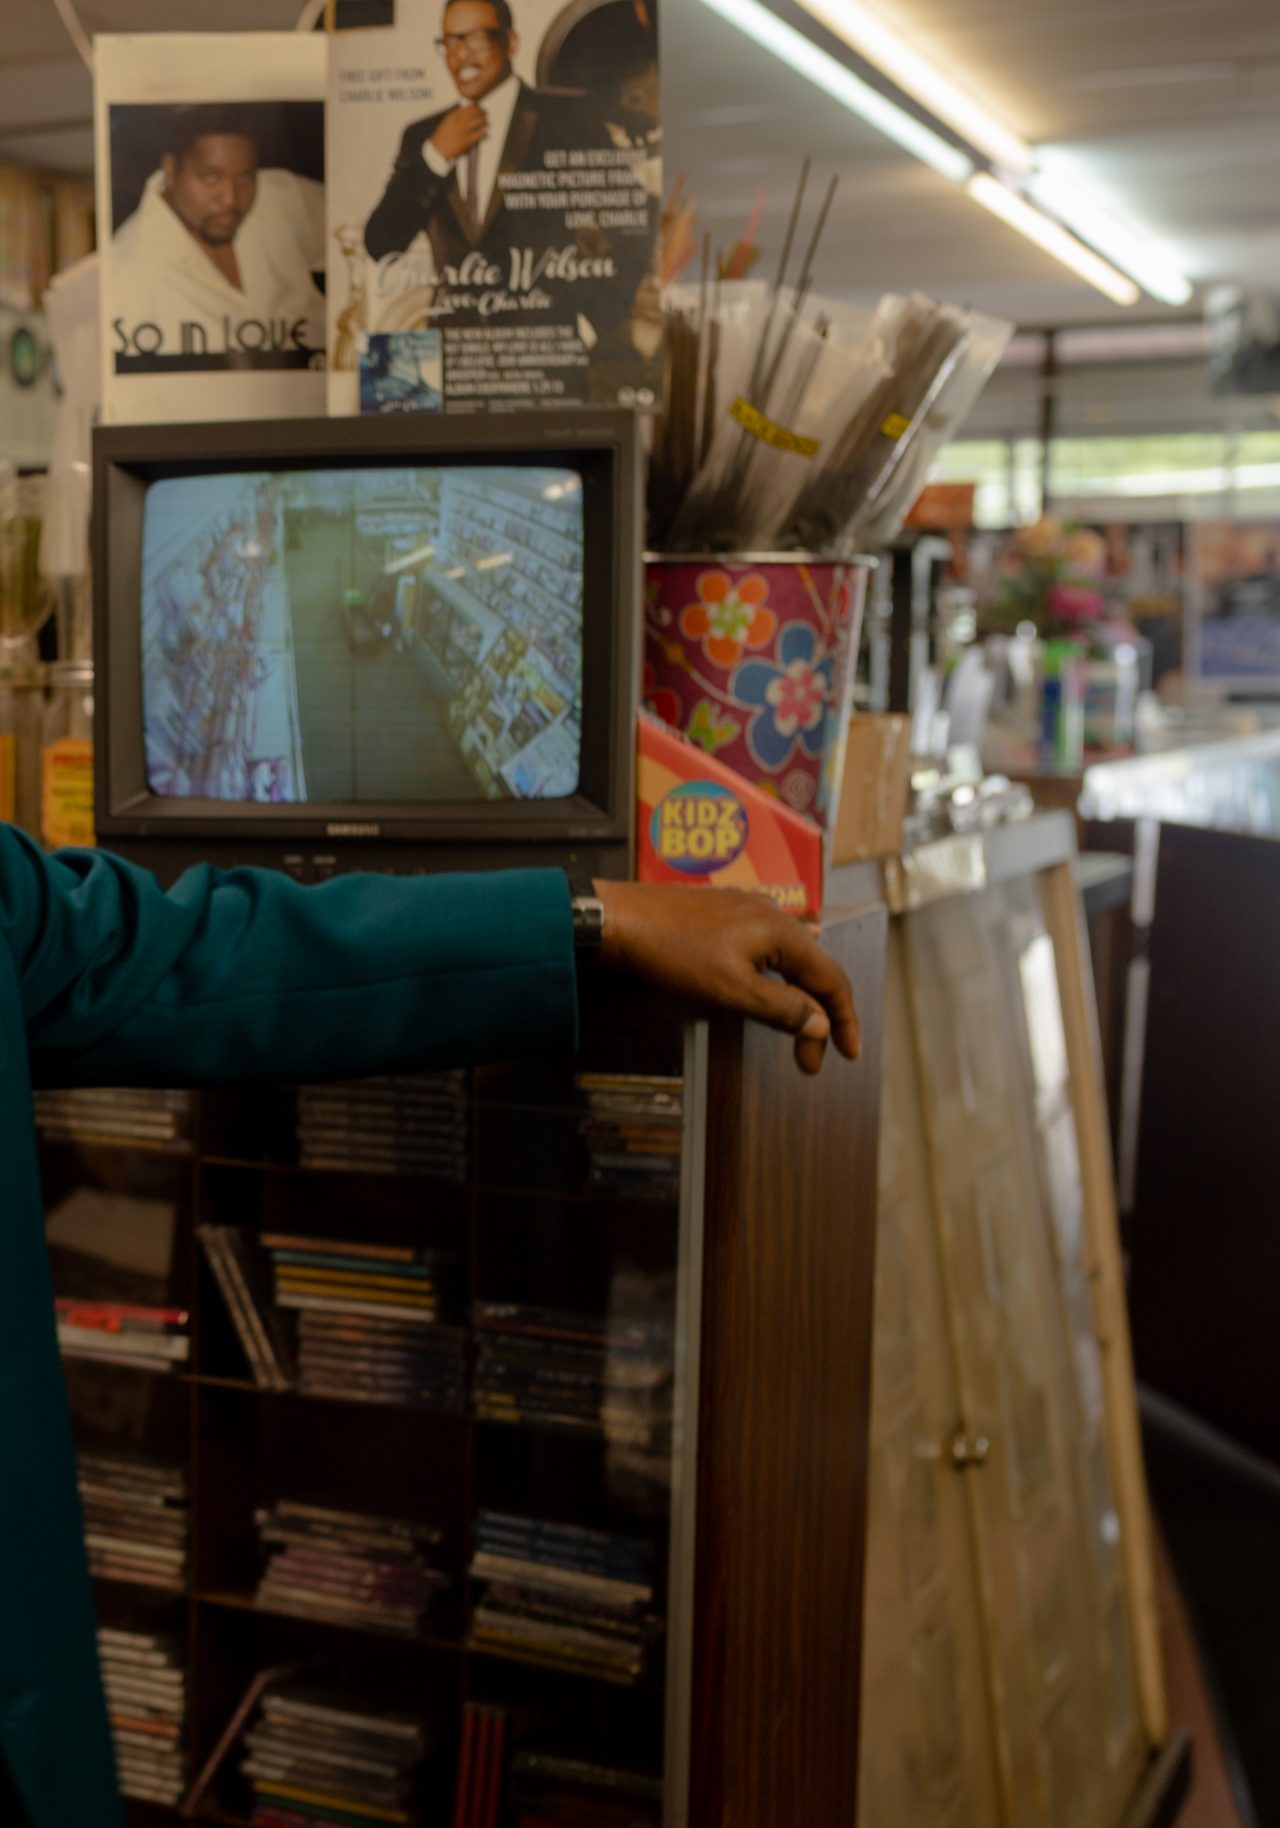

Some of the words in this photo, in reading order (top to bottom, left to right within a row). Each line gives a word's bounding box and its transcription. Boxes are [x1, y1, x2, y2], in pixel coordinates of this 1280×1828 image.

[544, 150, 567, 168] GET
[568, 150, 586, 167] AN
[497, 171, 556, 189] MAGNETIC
[557, 170, 605, 188] PICTURE
[504, 192, 537, 210] WITH
[538, 191, 568, 209] YOUR
[569, 190, 630, 208] PURCHASE
[598, 210, 648, 228] CHARLIE
[509, 245, 618, 292] Wilson
[661, 799, 739, 826] KIDZ
[661, 827, 740, 859] BOP
